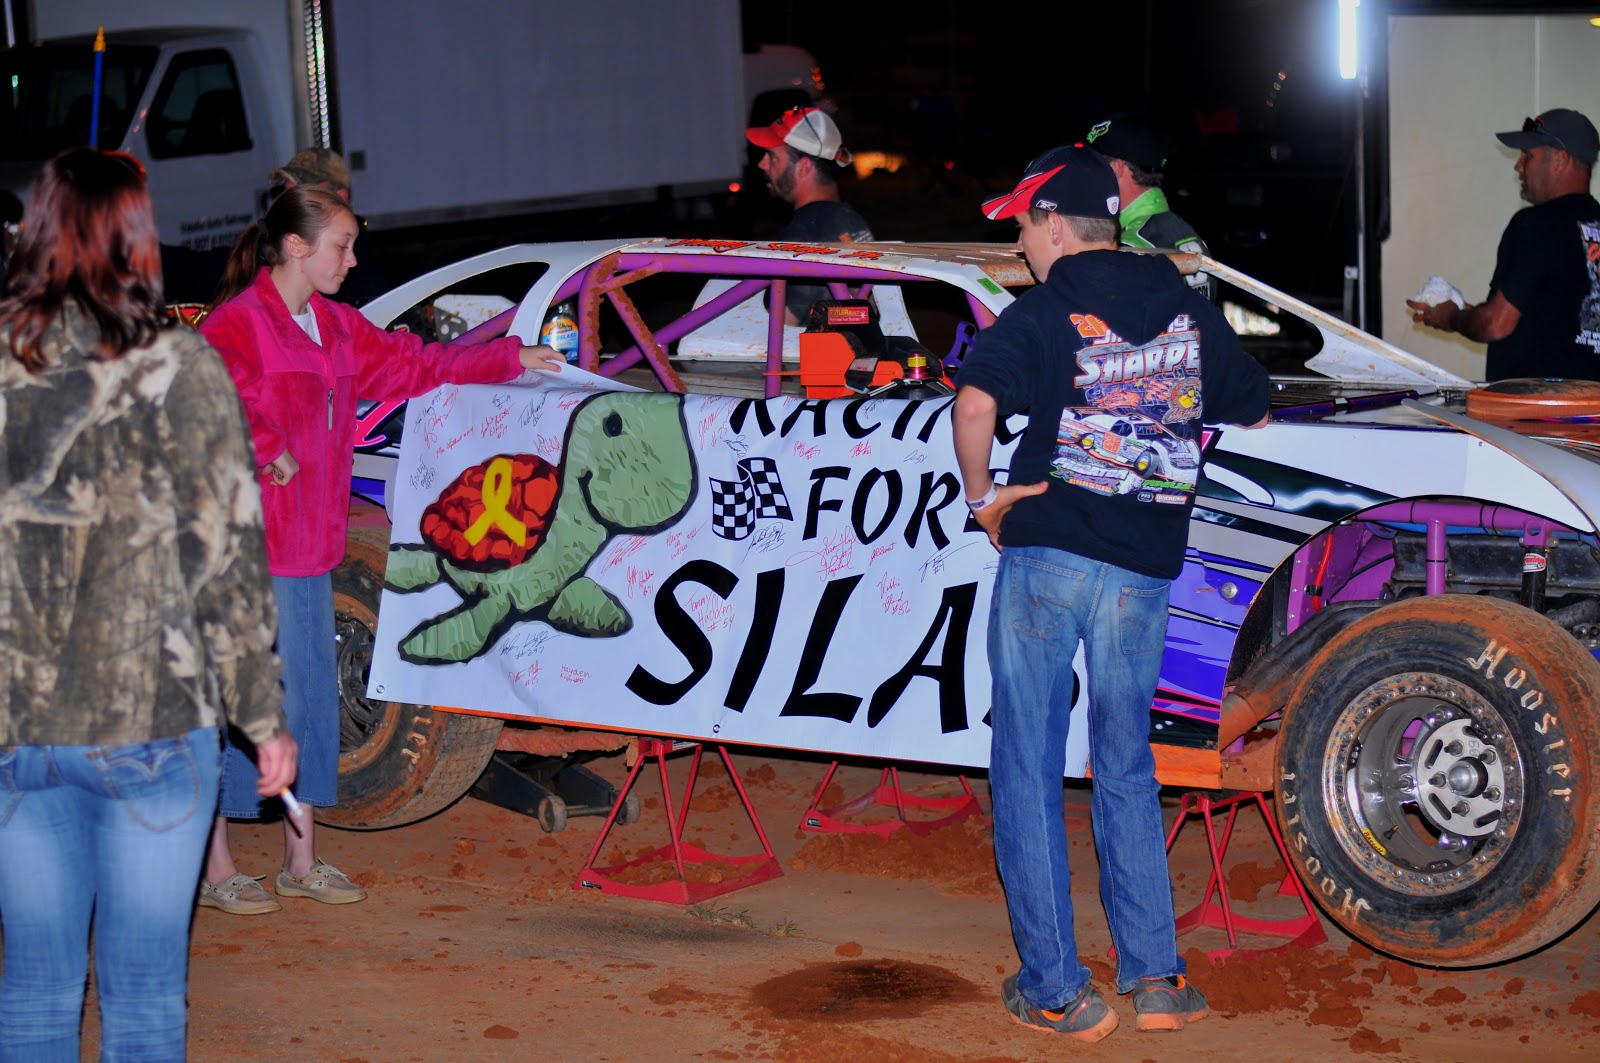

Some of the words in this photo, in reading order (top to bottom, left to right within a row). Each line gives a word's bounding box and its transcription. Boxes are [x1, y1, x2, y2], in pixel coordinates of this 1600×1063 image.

[1074, 339, 1200, 388] SHARPE
[802, 465, 961, 551] FOR
[625, 559, 1080, 734] SILA
